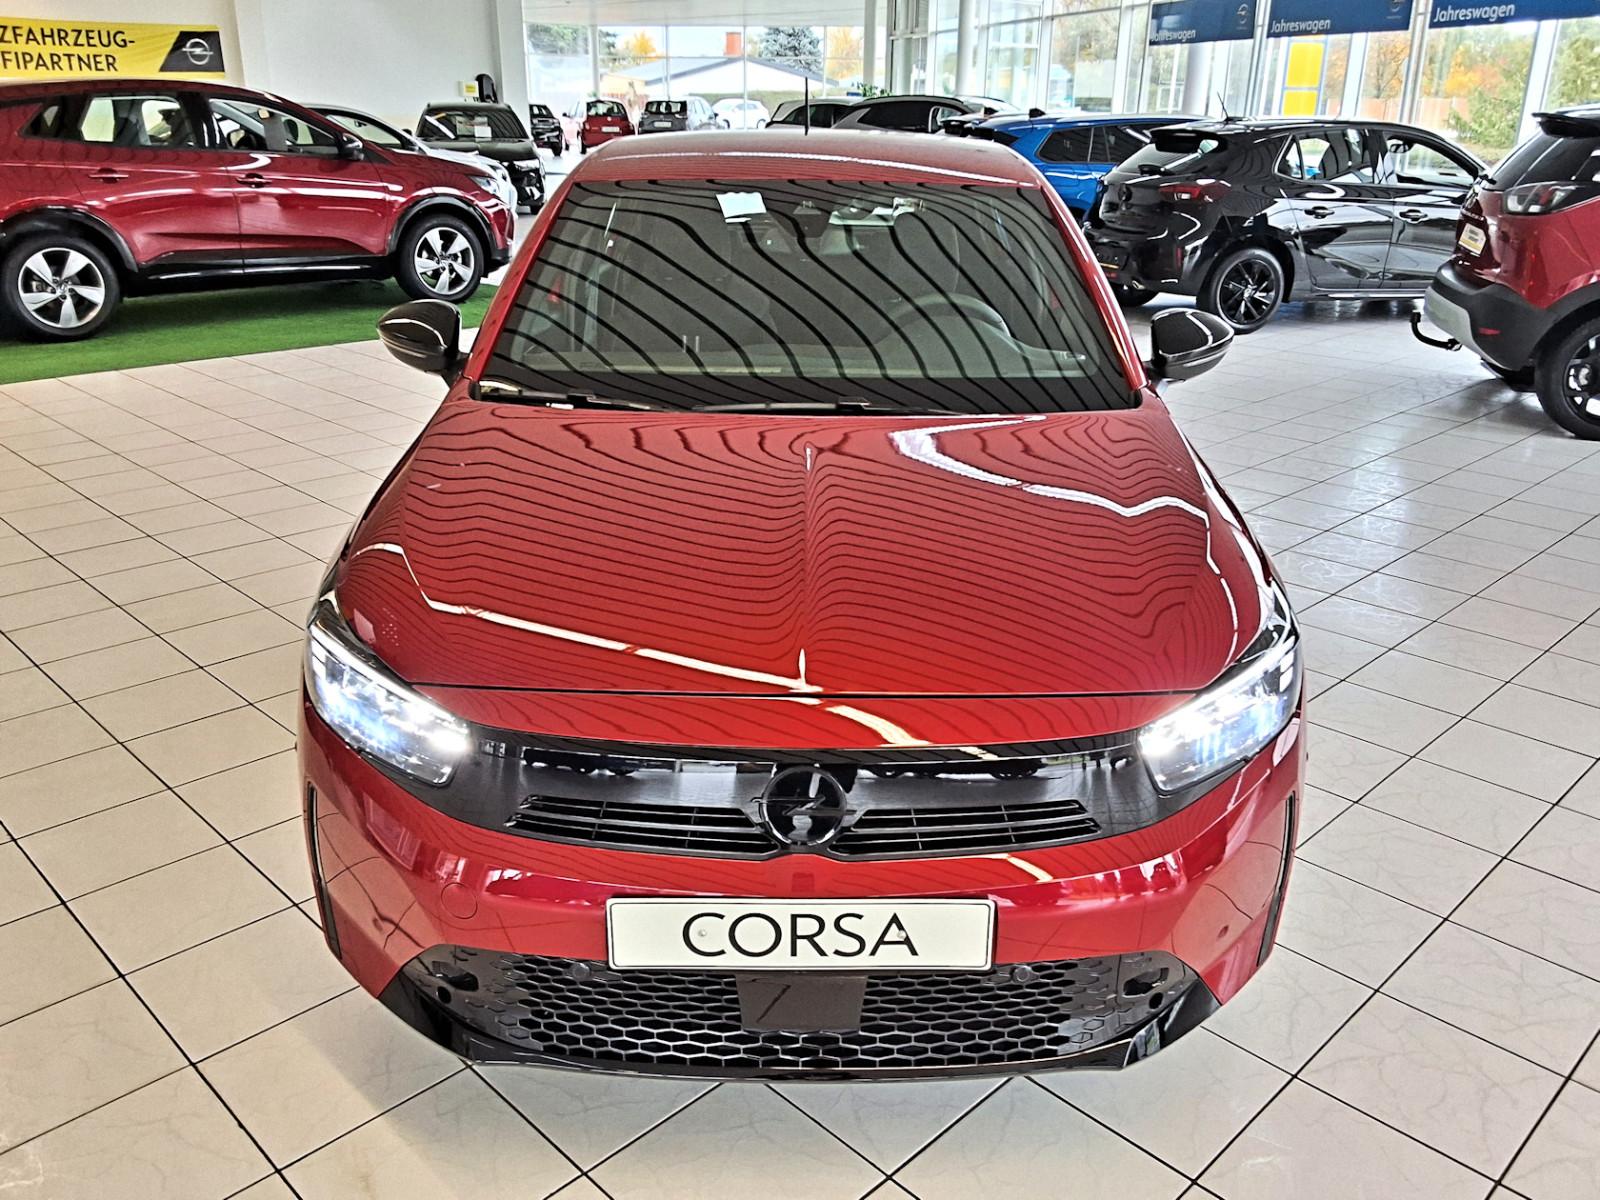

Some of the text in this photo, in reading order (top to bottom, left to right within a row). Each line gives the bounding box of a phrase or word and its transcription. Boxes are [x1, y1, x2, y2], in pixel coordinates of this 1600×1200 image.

[1433, 2, 1515, 23] Jahreswagen
[1271, 18, 1331, 33] Jahreswagen
[0, 25, 135, 48] ZFAHRZEUG-
[1, 51, 118, 71] FIPARTNER
[682, 912, 919, 958] CORSA
